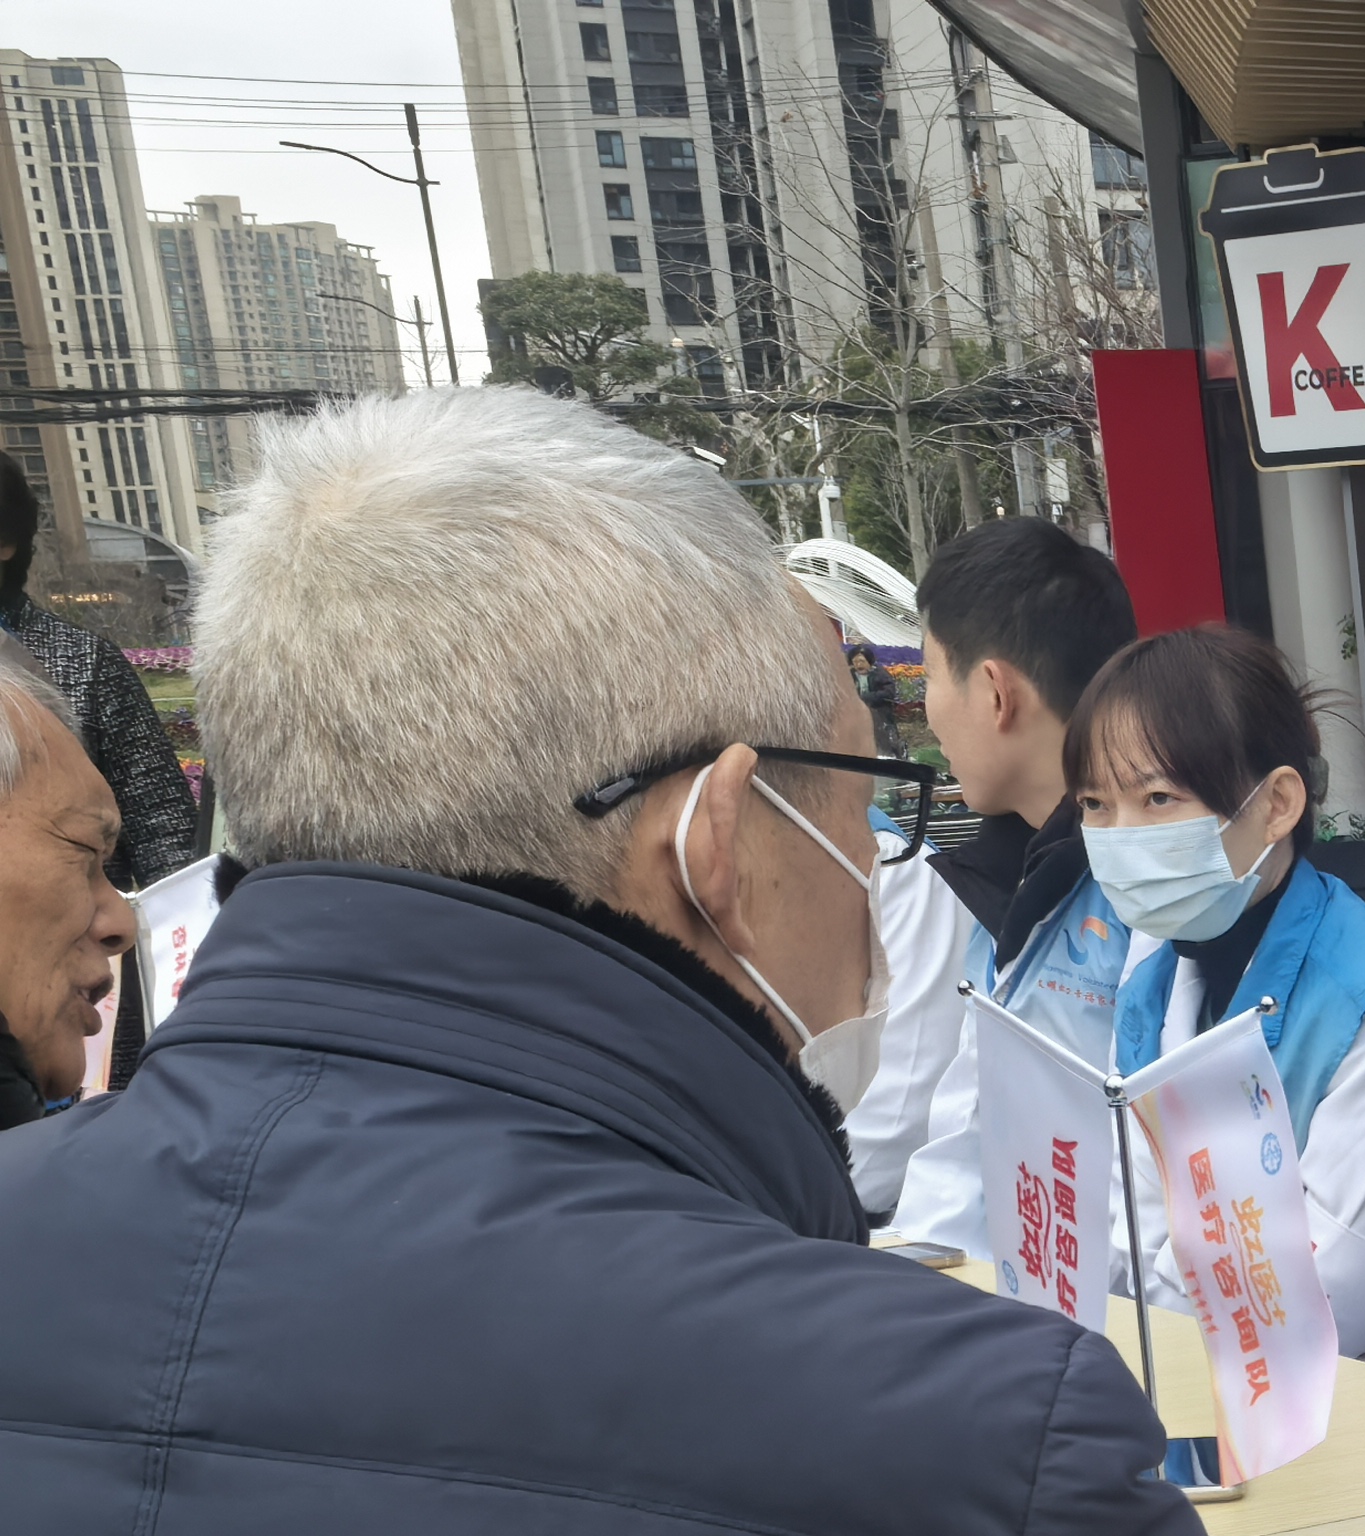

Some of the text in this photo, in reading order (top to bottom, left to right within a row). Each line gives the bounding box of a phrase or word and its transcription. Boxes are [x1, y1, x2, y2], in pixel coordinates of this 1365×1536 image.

[1187, 1147, 1271, 1407] 医疗咨询队
